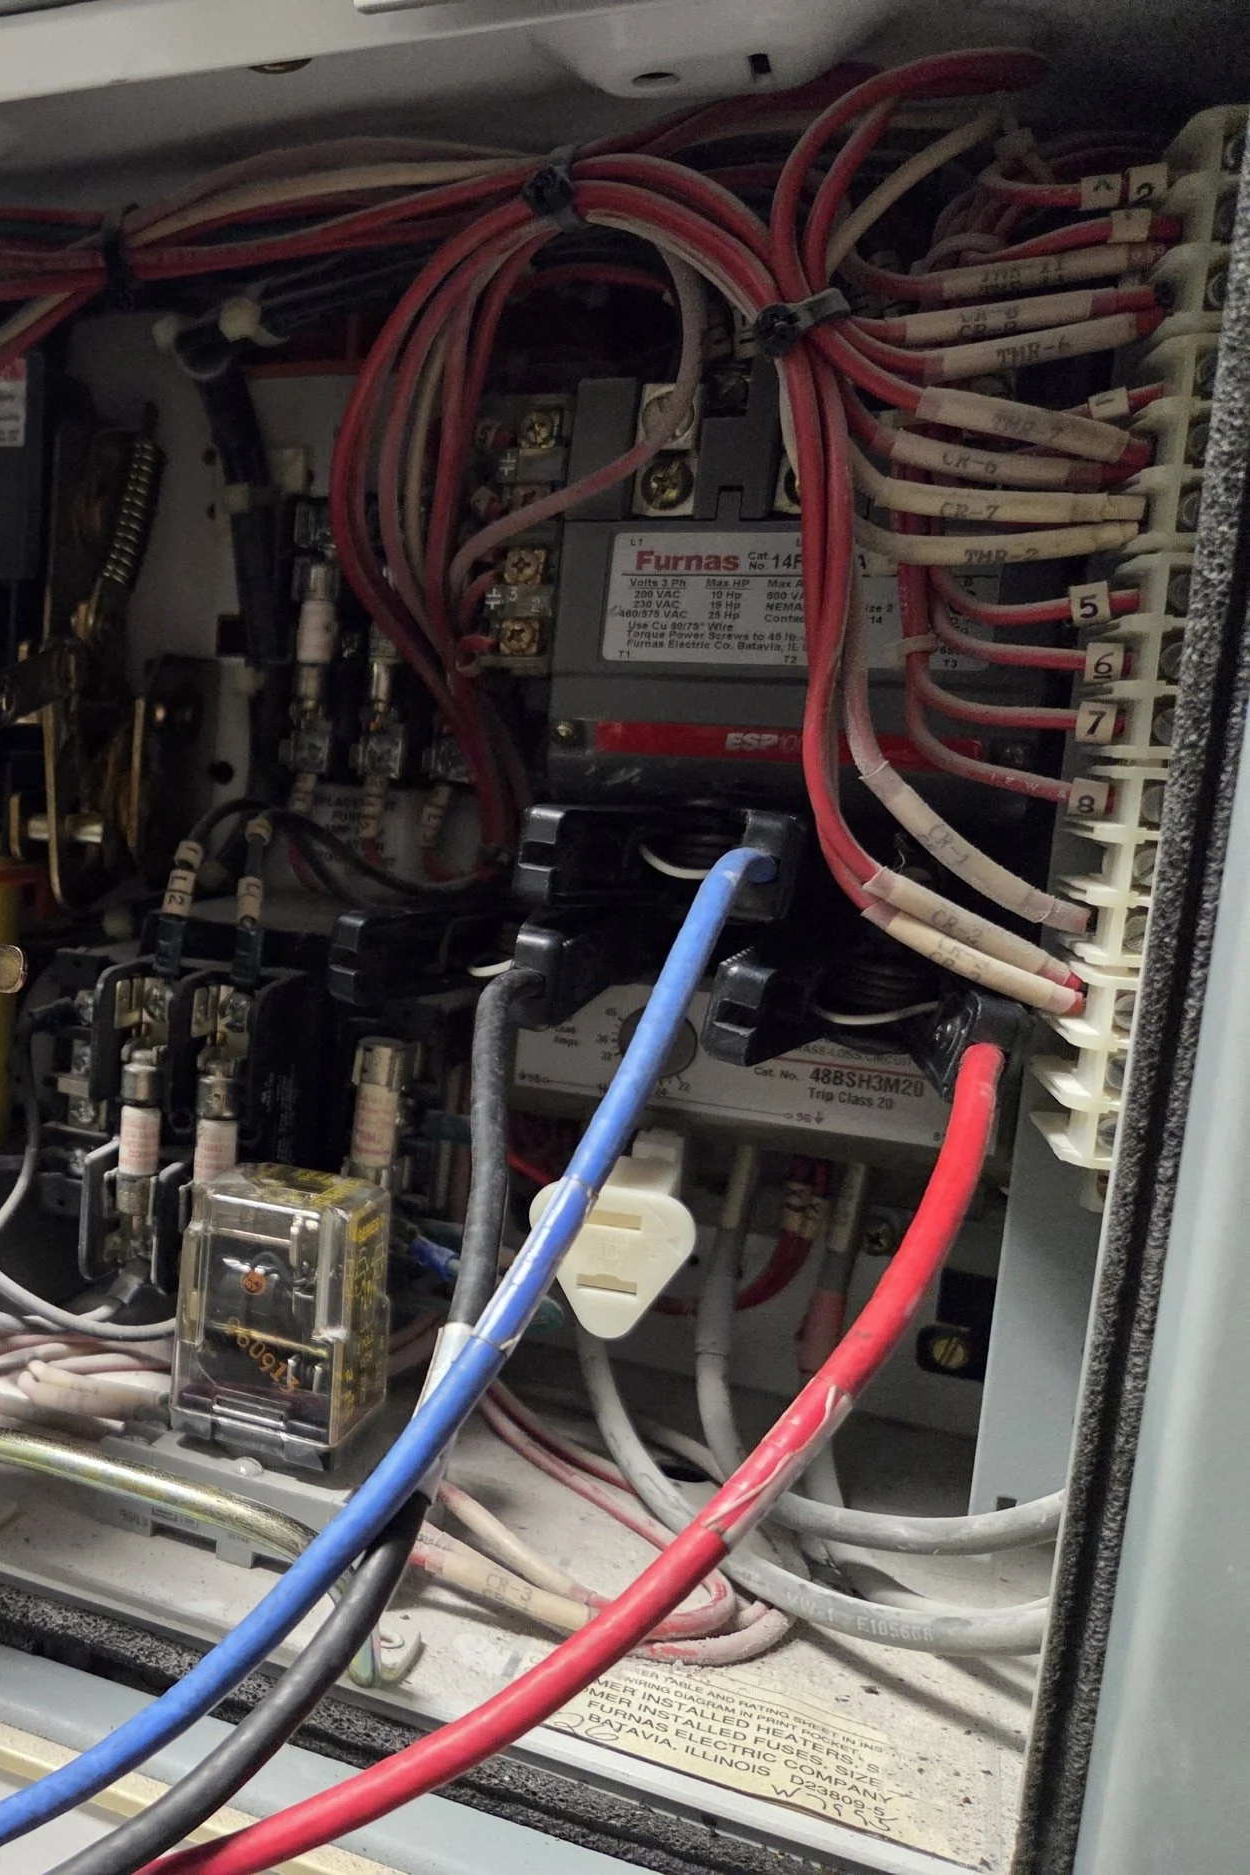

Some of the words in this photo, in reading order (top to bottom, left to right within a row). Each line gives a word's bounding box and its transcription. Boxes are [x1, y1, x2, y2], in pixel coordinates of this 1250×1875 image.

[635, 550, 739, 571] Furnas
[630, 579, 659, 588] Volts
[706, 579, 730, 588] Max
[732, 580, 750, 588] HP
[1079, 594, 1097, 619] 5
[667, 640, 710, 649] Electric
[669, 631, 704, 639] Power
[708, 632, 749, 641] Screws
[1094, 656, 1111, 681] 6
[1088, 711, 1106, 737] 7
[1078, 795, 1094, 813] 8
[754, 1066, 775, 1077] Cat.
[780, 1070, 799, 1081] No.
[808, 1067, 925, 1097] 48BSH3M20
[808, 1087, 834, 1102] Trip
[838, 1092, 873, 1107] Class
[878, 1097, 892, 1109] 20
[642, 1692, 750, 1729] INSTALLED
[662, 1675, 703, 1693] TABLE
[707, 1691, 735, 1703] AND
[739, 1700, 790, 1719] RATING
[793, 1716, 838, 1738] SHEET
[842, 1735, 856, 1745] IN
[673, 1691, 735, 1714] DIAGRAM
[739, 1710, 753, 1719] IN
[756, 1714, 799, 1731] PRINT
[587, 1700, 669, 1733] FURNAS
[675, 1728, 777, 1764] ELECTRIC
[784, 1759, 893, 1804] COMPANY
[638, 1703, 747, 1742] INSTALLED
[835, 1764, 883, 1788] SIZE
[684, 1745, 771, 1777] ILLINOIS
[789, 1774, 885, 1817] D23809-5
